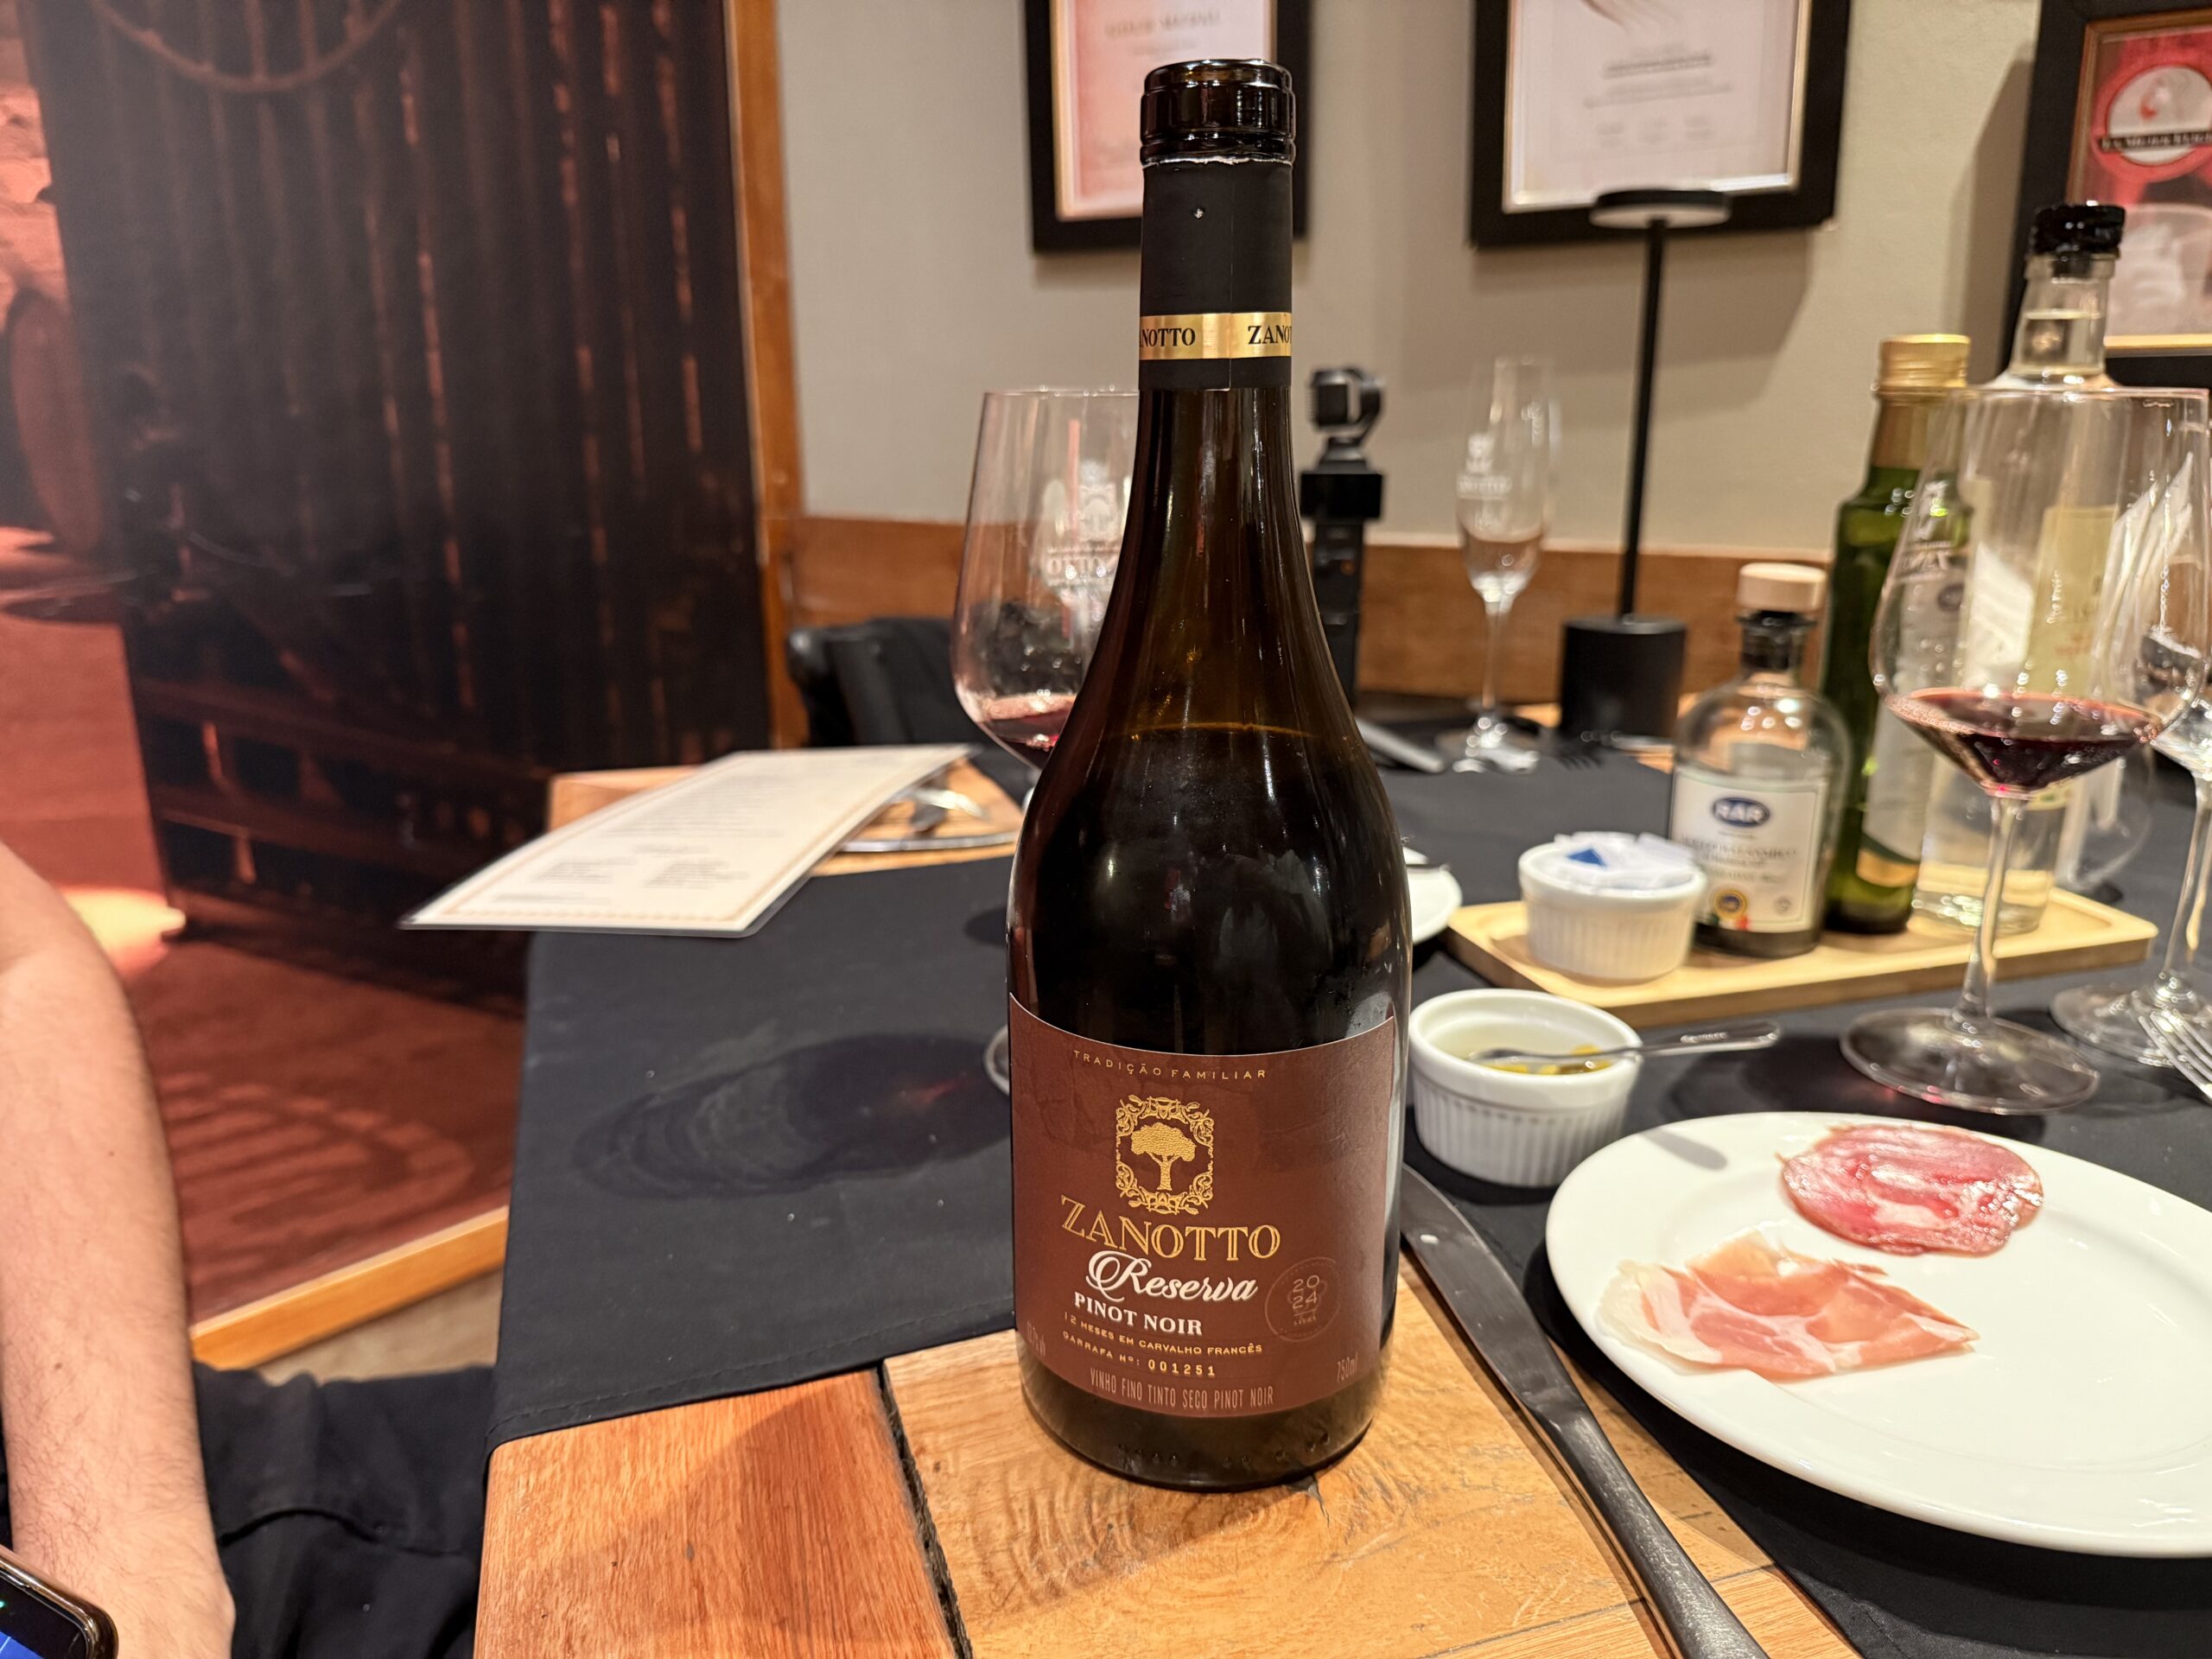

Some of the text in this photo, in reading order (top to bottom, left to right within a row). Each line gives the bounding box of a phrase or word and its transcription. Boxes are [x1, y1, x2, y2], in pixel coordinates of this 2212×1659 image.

[1073, 1050, 1266, 1080] TRADIÇÃO FAMILIAR
[1060, 1194, 1281, 1262] ZANOTTO
[1085, 1249, 1258, 1302] Reserva
[1293, 1274, 1319, 1293] 20
[1074, 1292, 1203, 1336] PINOT NOIR
[1292, 1290, 1318, 1310] 24
[1063, 1331, 1114, 1359] GARRAFA
[1147, 1358, 1216, 1376] 001251
[1080, 1320, 1115, 1340] MESES
[1119, 1334, 1135, 1346] EM
[1139, 1339, 1203, 1355] CARVALHO
[1207, 1342, 1262, 1356] FRANCÊS
[1090, 1367, 1274, 1410] VINHO FINO TINTO SECO PINOT NOIR
